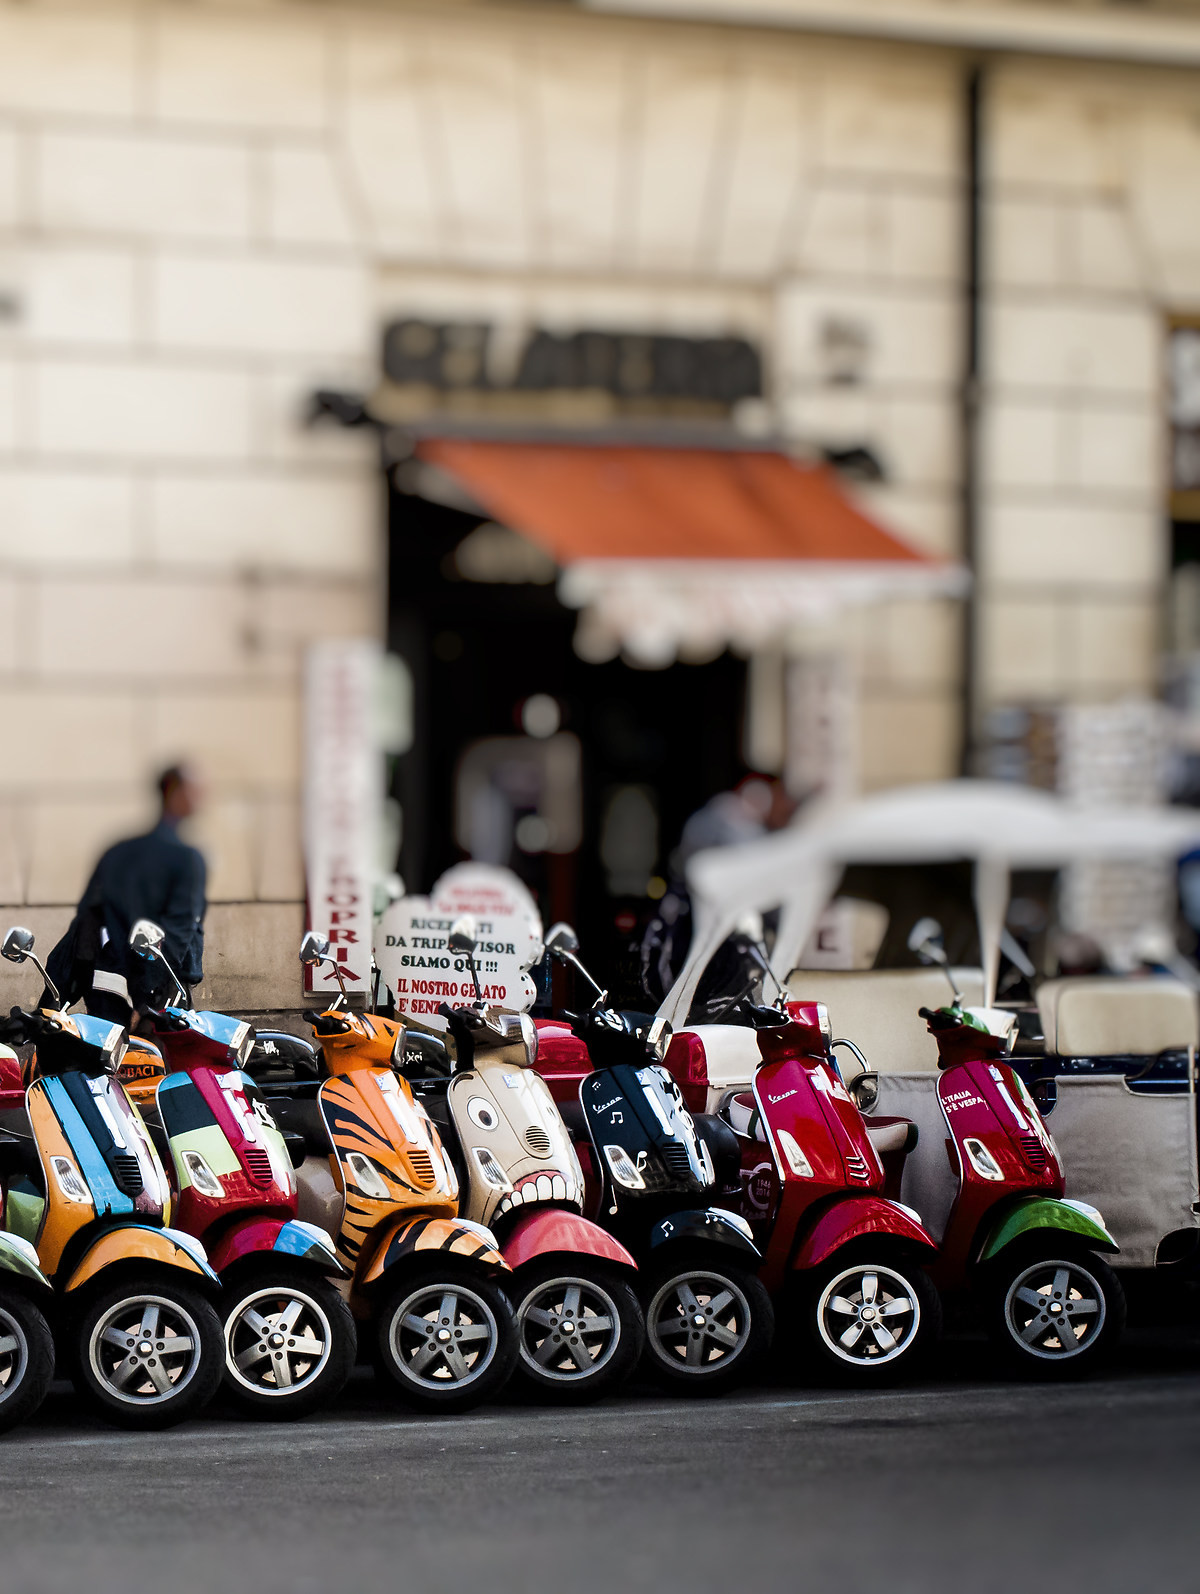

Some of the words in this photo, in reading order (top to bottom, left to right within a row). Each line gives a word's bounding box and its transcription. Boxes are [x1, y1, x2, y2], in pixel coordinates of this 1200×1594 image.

[411, 918, 493, 934] RICETI
[385, 935, 407, 947] DA
[411, 937, 516, 955] TRIPVISOR
[400, 955, 451, 969] SIAMO
[453, 958, 482, 973] QUI
[397, 978, 409, 993] IL
[411, 979, 458, 997] NOSTRO
[460, 983, 507, 1000] GEATO
[411, 999, 443, 1015] SENZ
[592, 1096, 623, 1115] Vespa
[767, 1089, 799, 1105] Vespa
[941, 1090, 972, 1105] L'ITALIA
